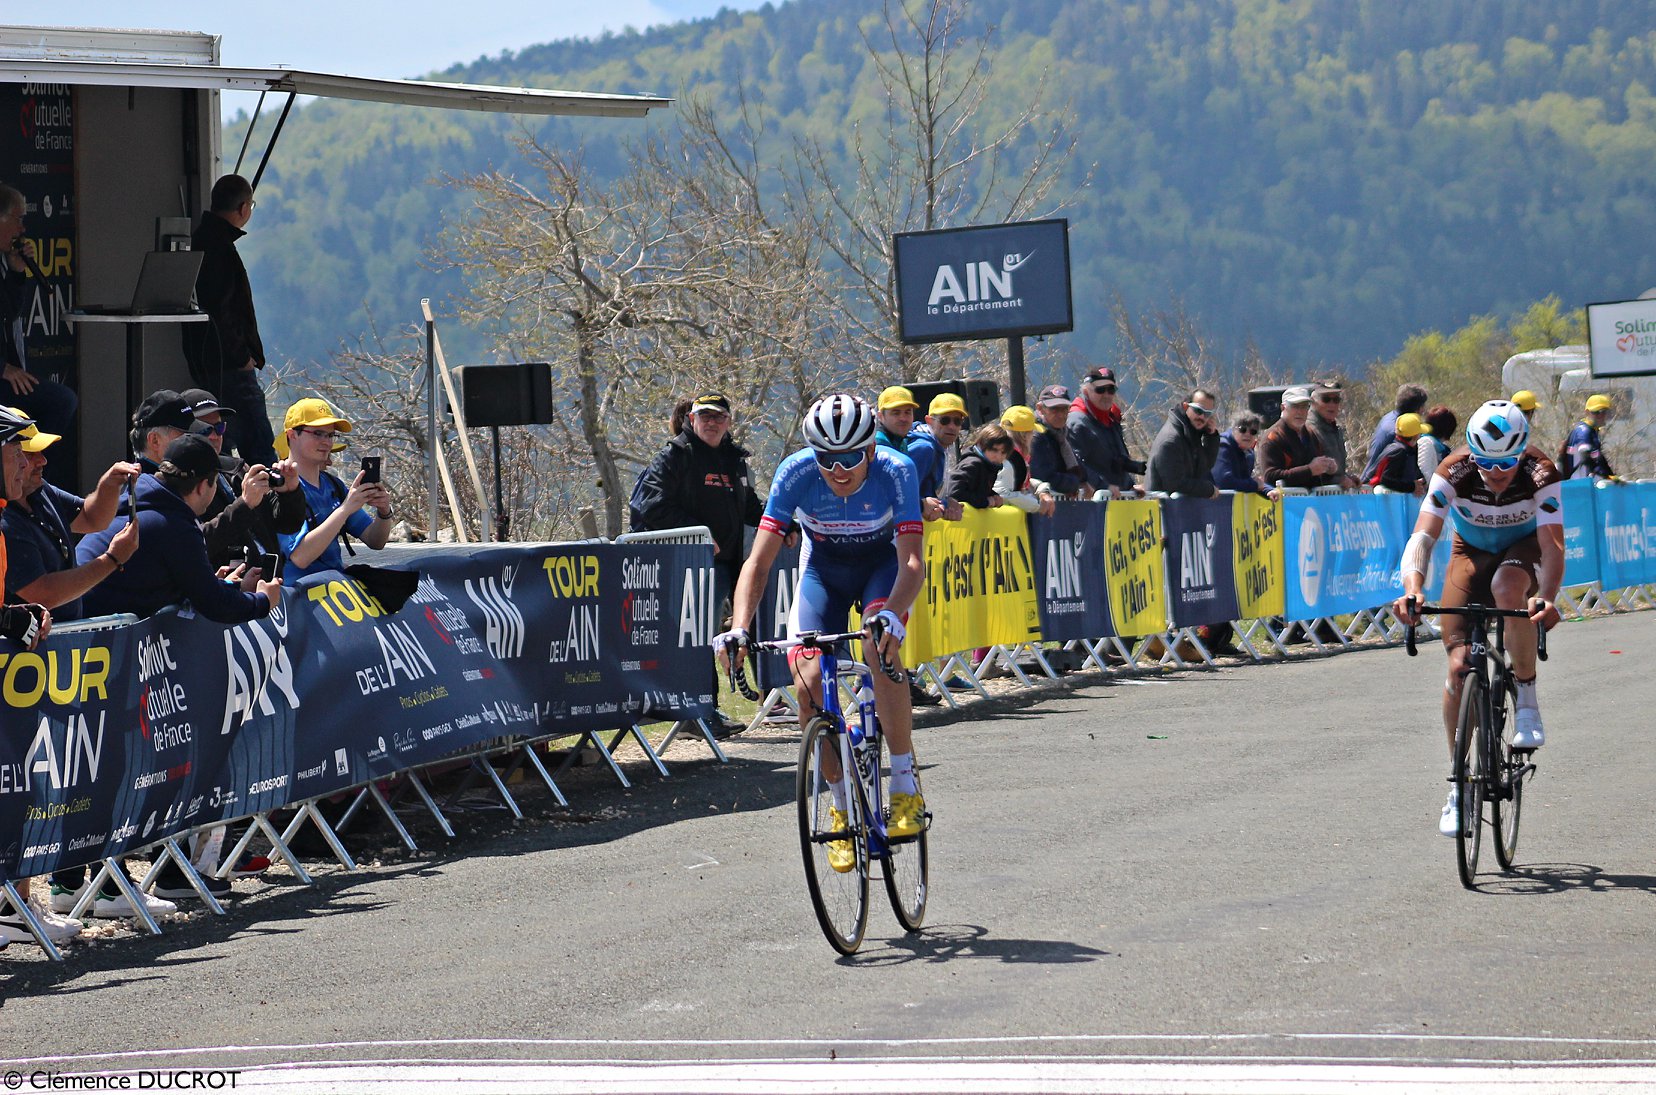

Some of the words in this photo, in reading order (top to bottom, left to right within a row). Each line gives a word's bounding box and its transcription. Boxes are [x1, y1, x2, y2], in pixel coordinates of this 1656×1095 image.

[35, 130, 45, 149] de
[46, 131, 72, 149] France
[25, 238, 72, 278] OUR
[928, 261, 1012, 305] AIN
[1006, 253, 1021, 264] 01
[928, 306, 938, 315] le
[944, 298, 1022, 315] Département
[1615, 319, 1656, 335] Solim
[1108, 531, 1128, 577] Ici,
[1128, 509, 1157, 562] c'est
[1236, 528, 1253, 564] Ici,
[1253, 502, 1278, 550] c'est
[543, 556, 600, 598] TOUR
[622, 557, 660, 590] Solimut
[943, 543, 975, 602] c'est
[1046, 540, 1081, 598] AIN
[1181, 531, 1214, 589] AIN
[1120, 574, 1148, 624] l'Ain
[1245, 561, 1268, 608] l'Ain
[464, 576, 525, 660] AIN
[631, 625, 640, 646] de
[639, 626, 659, 646] France
[355, 667, 380, 696] DE
[0, 764, 10, 794] E
[250, 774, 289, 795] EUROSPORT
[297, 765, 322, 781] PHILIBERT
